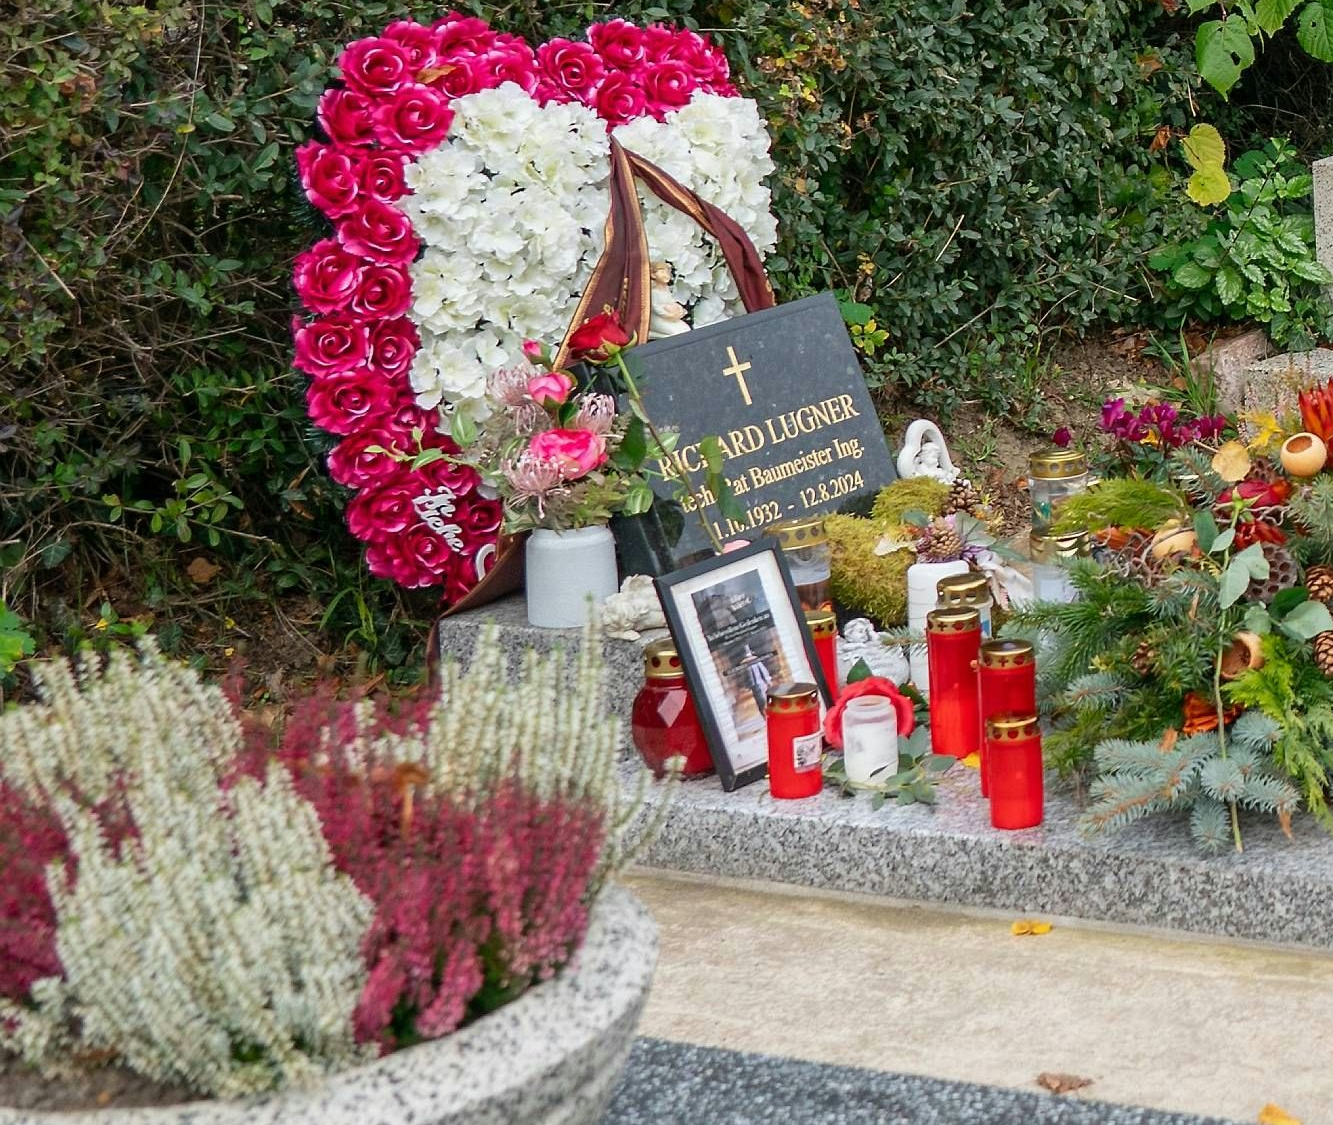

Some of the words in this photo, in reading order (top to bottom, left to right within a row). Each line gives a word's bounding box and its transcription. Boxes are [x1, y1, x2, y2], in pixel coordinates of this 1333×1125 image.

[764, 394, 860, 445] LUGNER
[749, 447, 832, 489] Baumeister
[833, 438, 864, 459] Ing.
[800, 470, 864, 509] 12.8.2024
